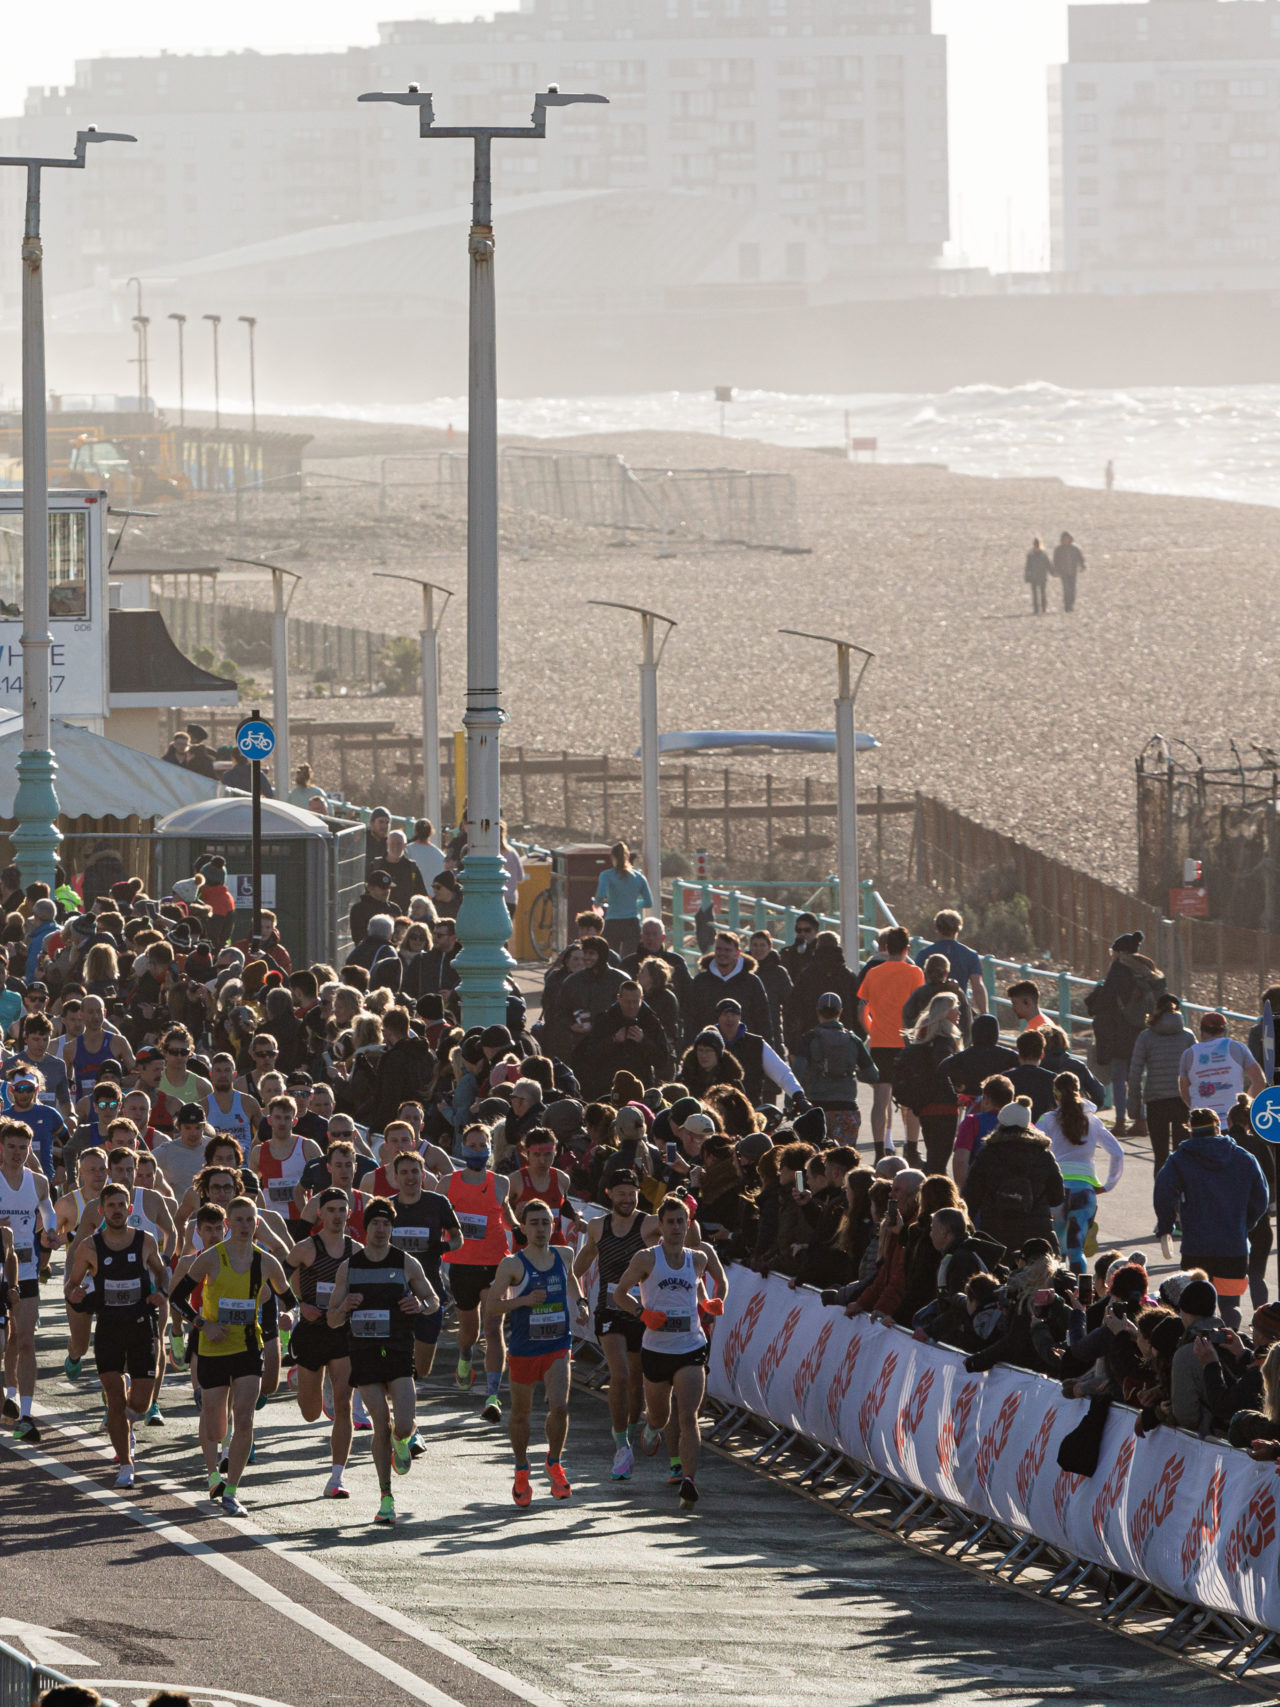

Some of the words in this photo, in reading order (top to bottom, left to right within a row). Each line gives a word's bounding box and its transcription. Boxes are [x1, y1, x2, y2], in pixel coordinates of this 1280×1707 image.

[656, 1278, 693, 1291] PHOENIX
[227, 1310, 247, 1320] 183
[363, 1321, 377, 1331] 44
